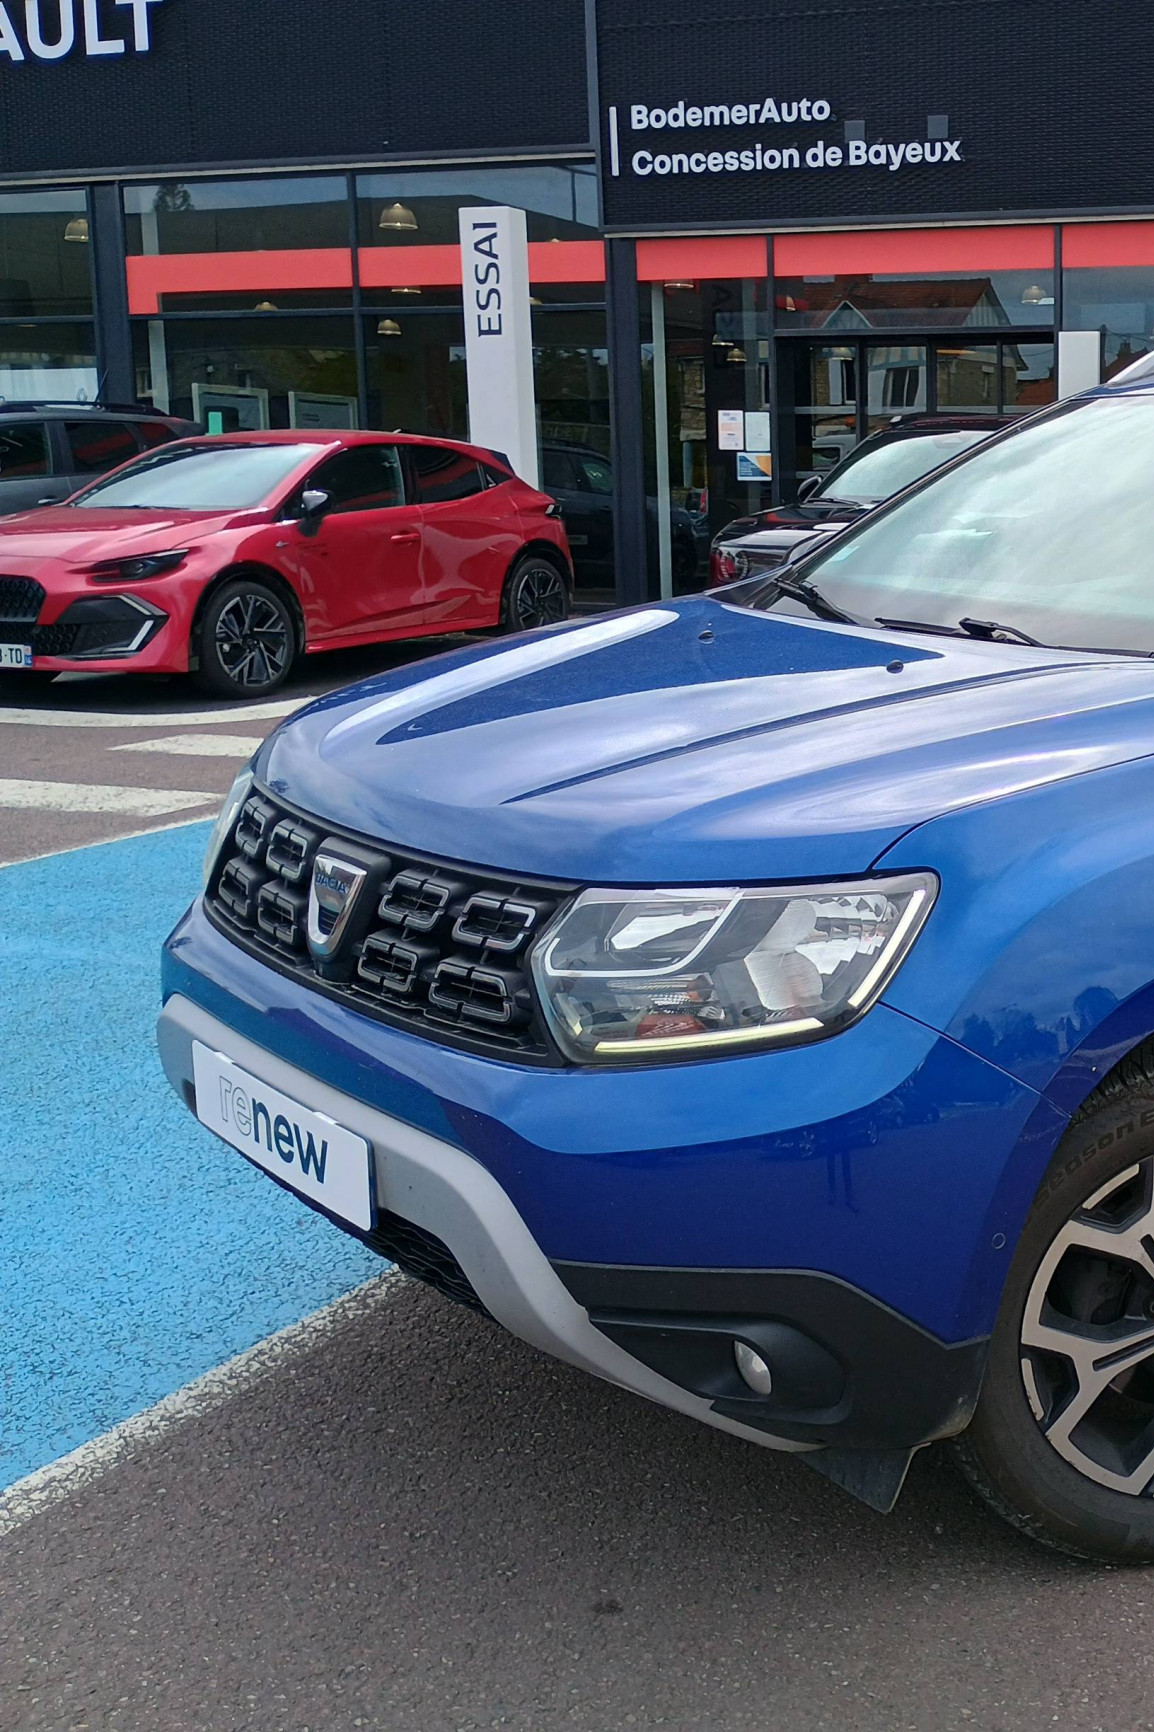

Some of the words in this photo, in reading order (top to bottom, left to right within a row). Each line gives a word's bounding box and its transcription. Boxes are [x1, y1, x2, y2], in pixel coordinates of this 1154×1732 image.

[631, 97, 831, 130] BodemerAuto
[631, 143, 800, 176] Concession
[805, 140, 843, 168] de
[848, 140, 962, 171] Bayeux
[472, 221, 503, 338] ESSAI
[0, 647, 23, 664] -TO
[218, 1075, 329, 1185] renew
